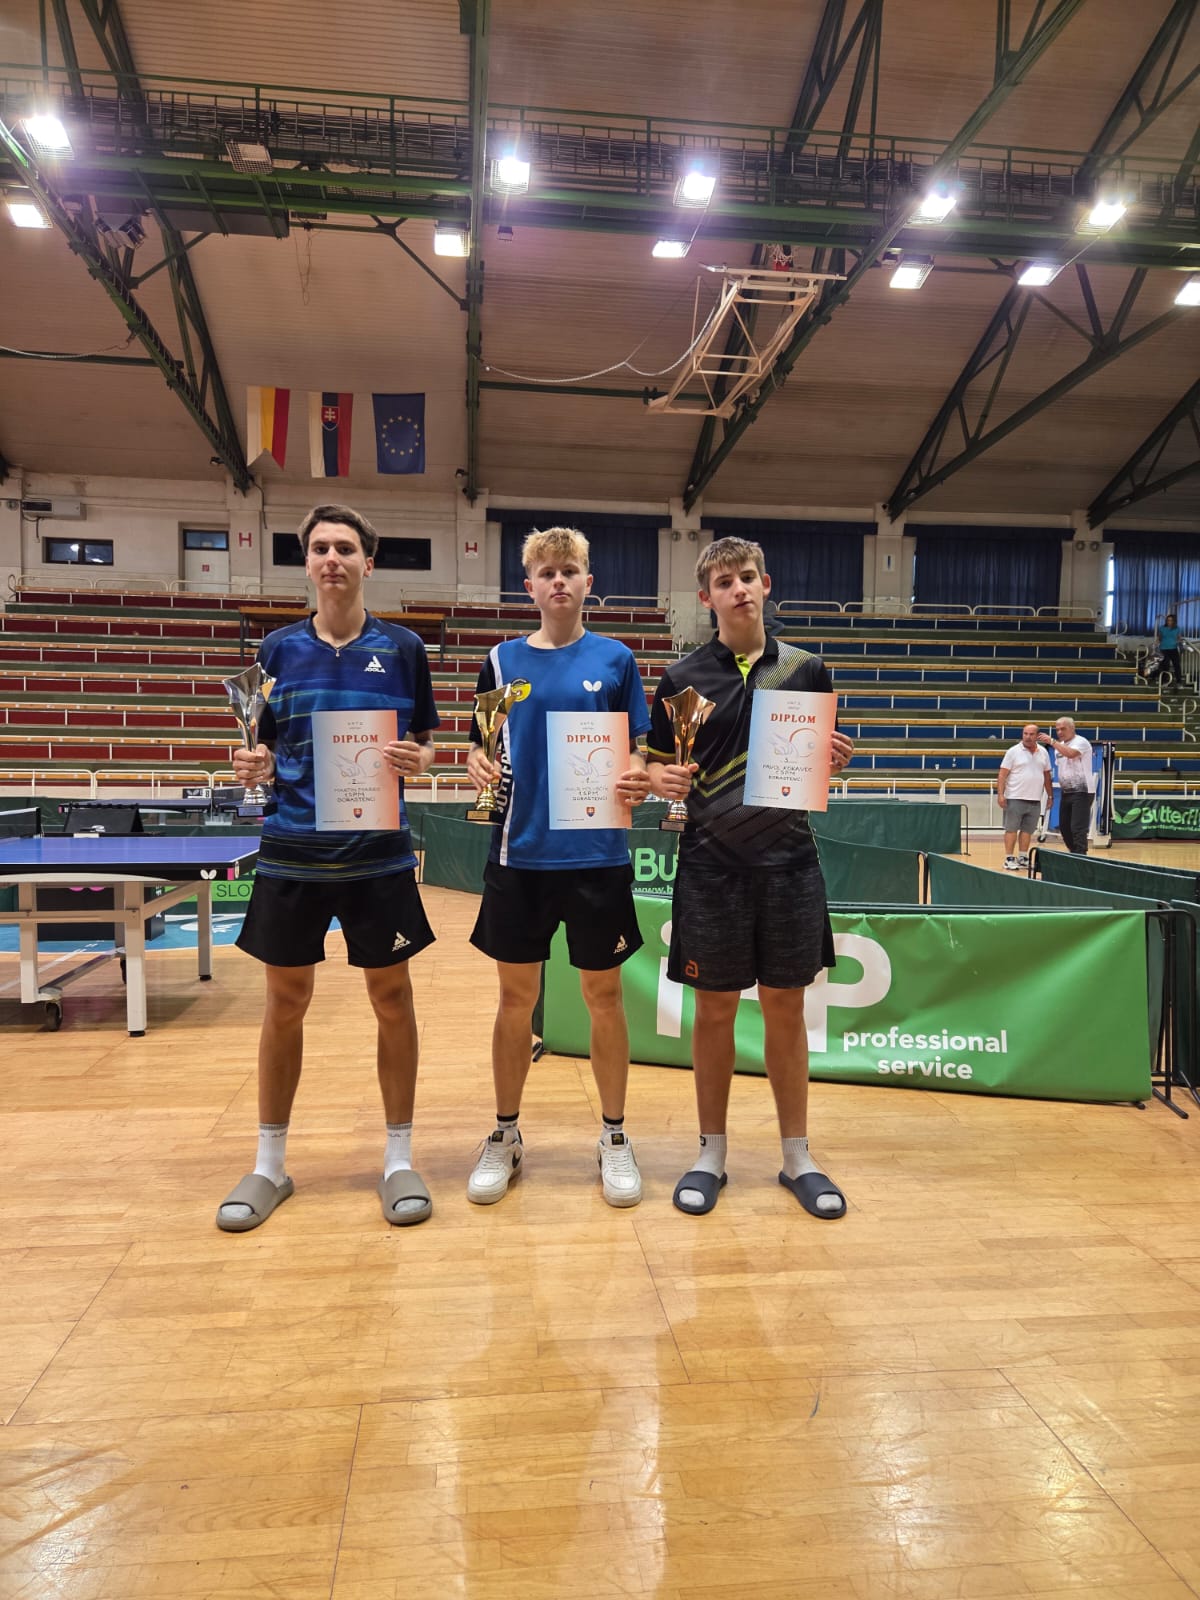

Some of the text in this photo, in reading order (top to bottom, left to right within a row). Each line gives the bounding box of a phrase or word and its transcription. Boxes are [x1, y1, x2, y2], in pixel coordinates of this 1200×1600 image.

[238, 532, 252, 548] H
[465, 541, 478, 553] H
[770, 713, 816, 724] DIPLOM
[333, 734, 378, 743] DIPLOM
[566, 734, 611, 744] DIPLOM
[1141, 805, 1200, 826] Butterfl
[216, 884, 254, 898] SLO
[842, 1026, 1008, 1053] professional
[877, 1055, 973, 1080] service
